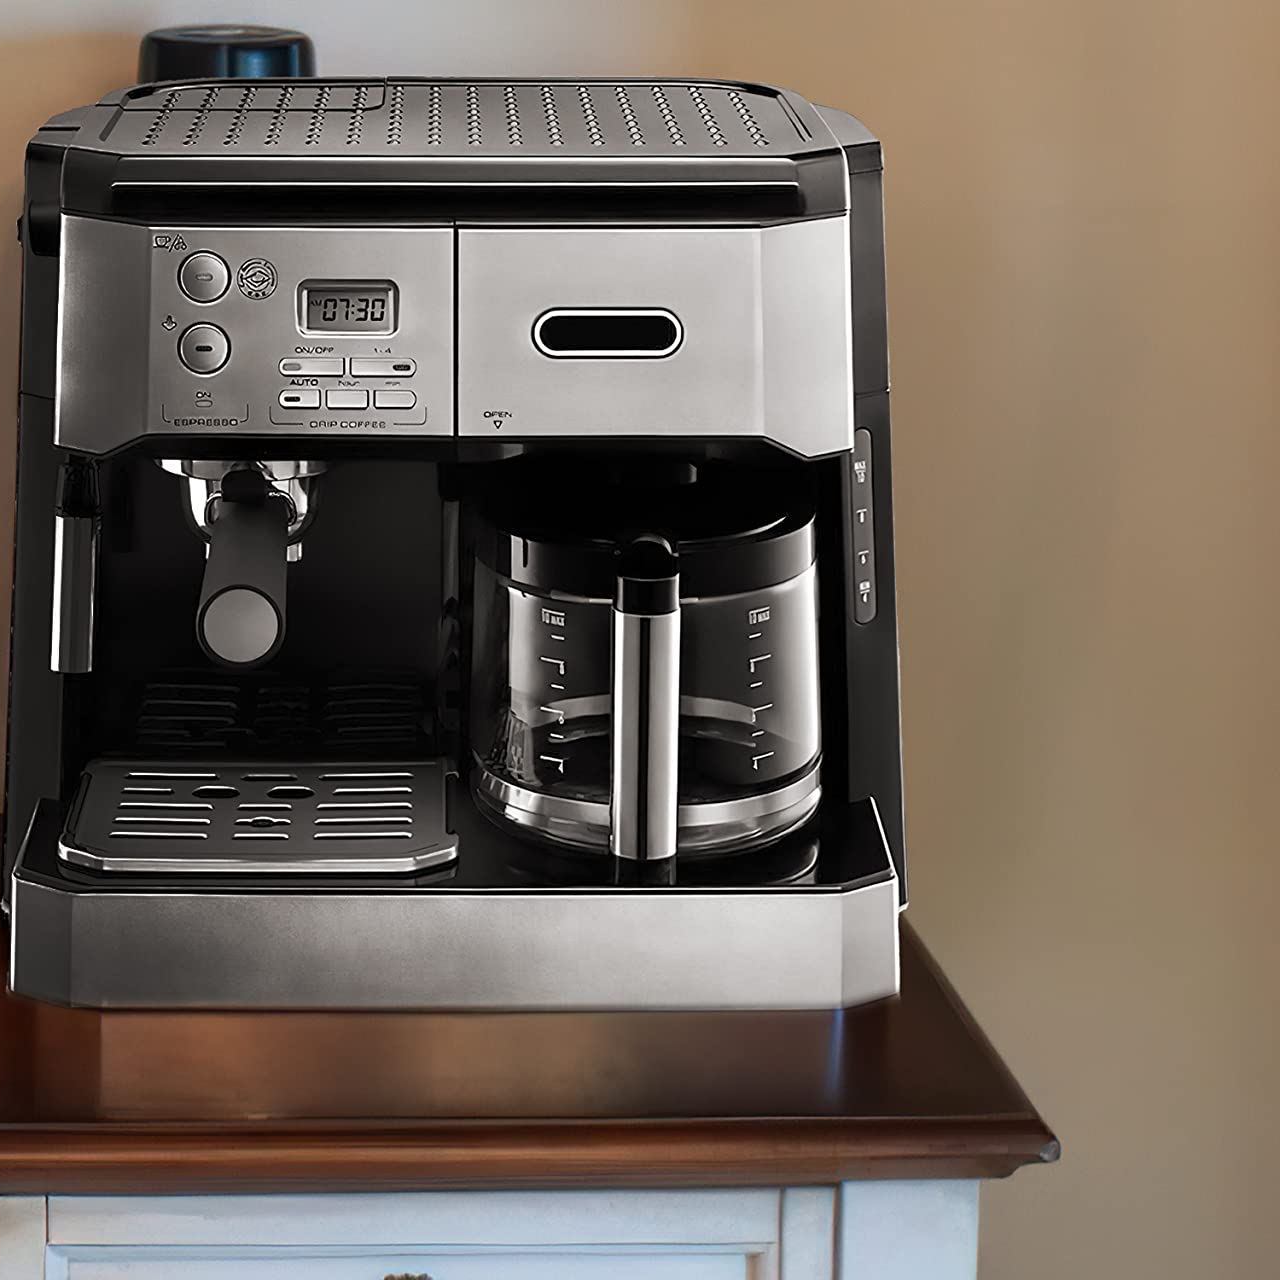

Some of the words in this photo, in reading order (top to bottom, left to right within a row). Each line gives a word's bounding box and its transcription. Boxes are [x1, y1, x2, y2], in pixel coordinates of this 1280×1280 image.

[322, 298, 386, 322] 07:30
[289, 378, 319, 388] AUTO
[195, 390, 212, 400] ON
[173, 417, 239, 427] ESPRESSO
[339, 420, 387, 429] COFFEE
